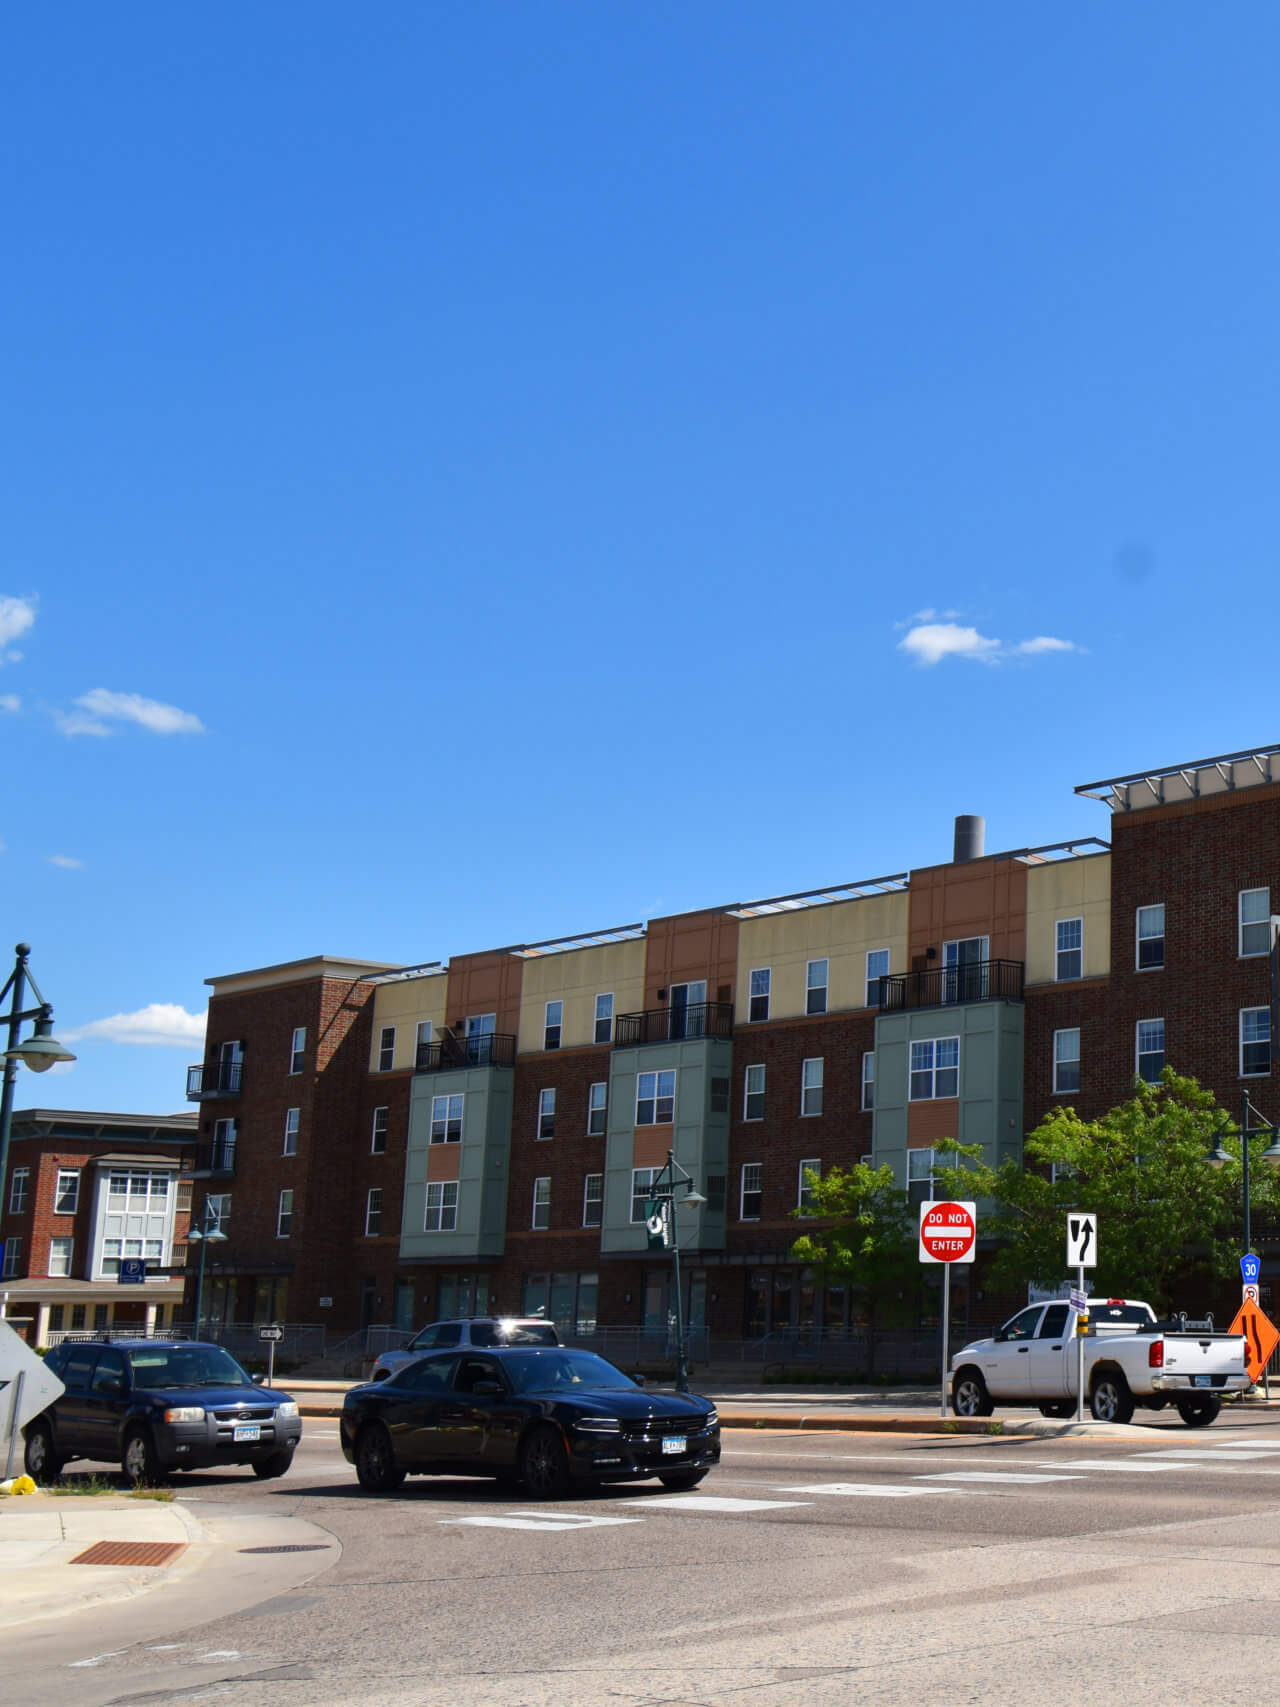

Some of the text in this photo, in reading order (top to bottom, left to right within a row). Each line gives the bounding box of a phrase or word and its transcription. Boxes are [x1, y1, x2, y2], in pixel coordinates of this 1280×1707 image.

[929, 1213, 968, 1225] DO NOT
[932, 1240, 964, 1251] ENTER
[1245, 1263, 1256, 1276] 30
